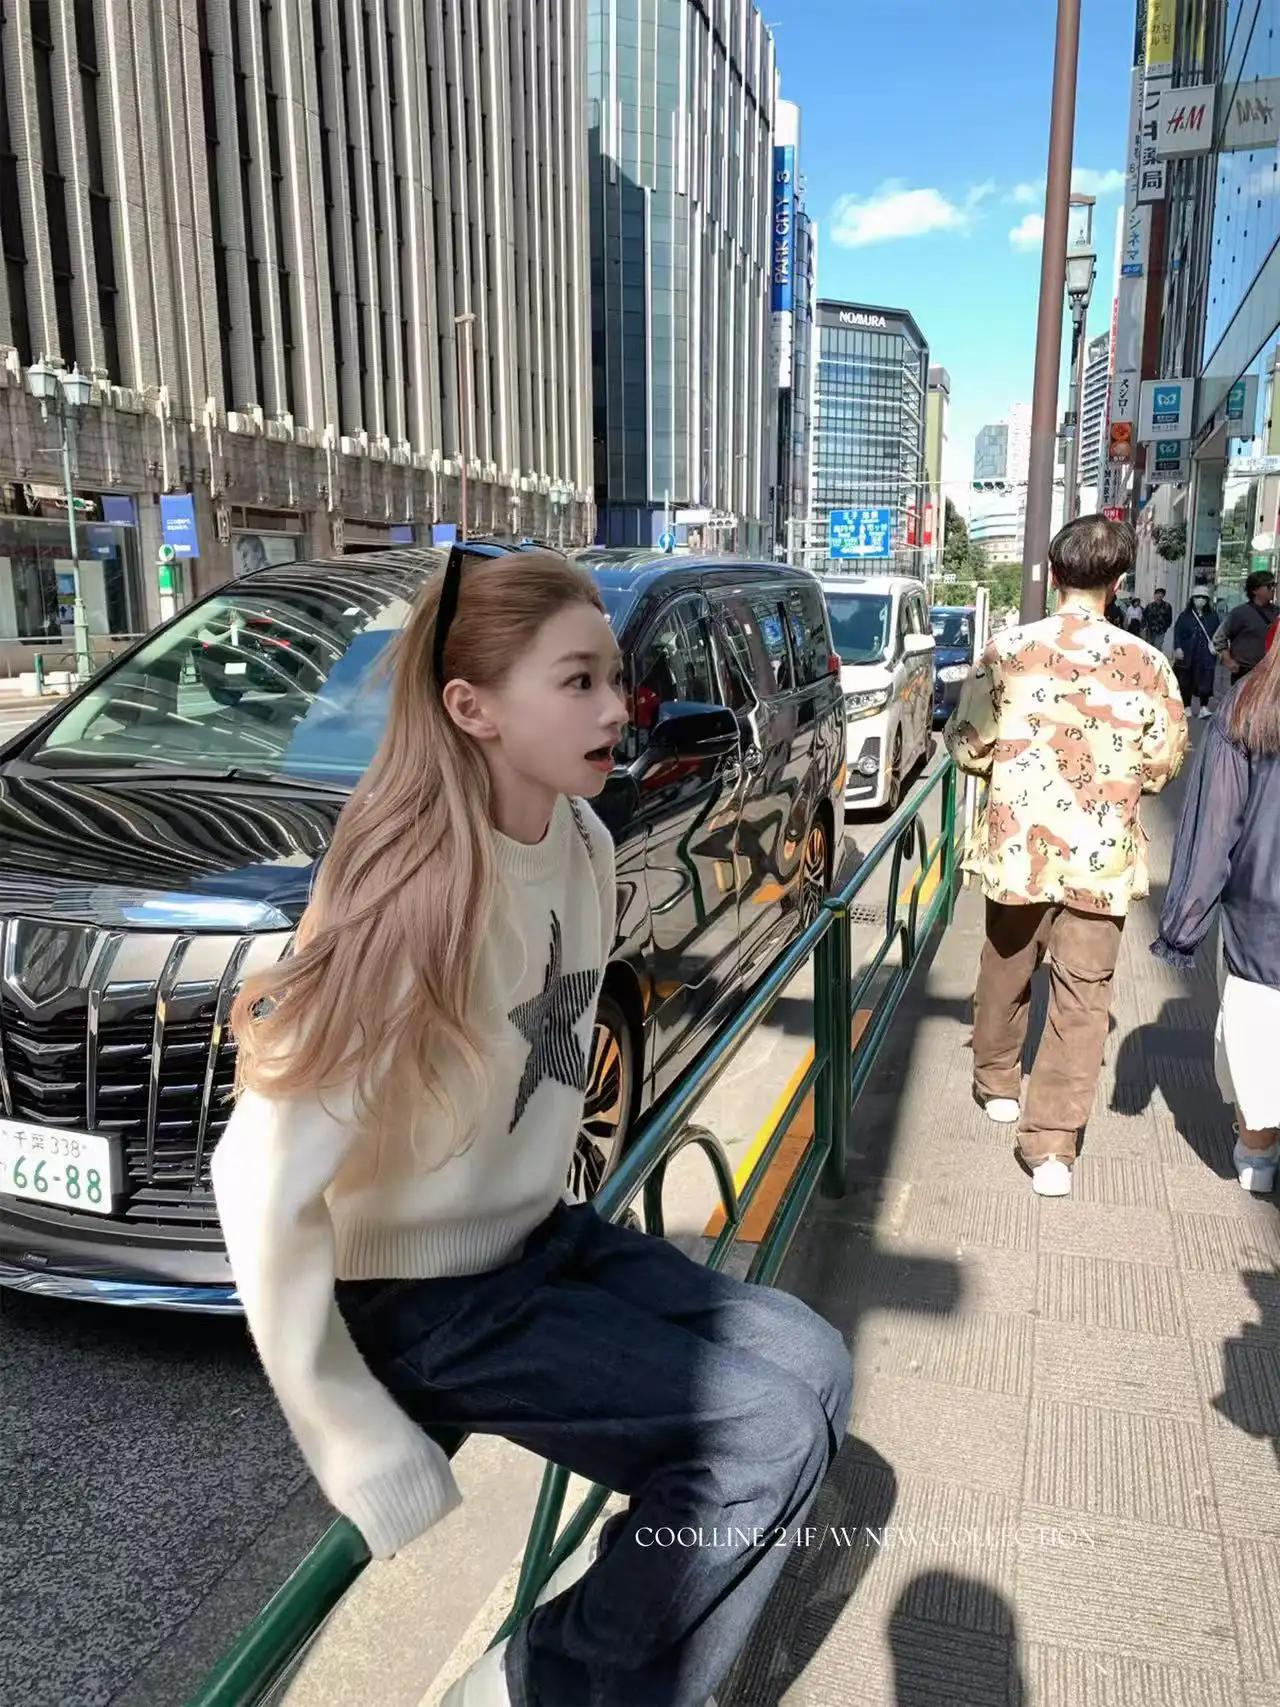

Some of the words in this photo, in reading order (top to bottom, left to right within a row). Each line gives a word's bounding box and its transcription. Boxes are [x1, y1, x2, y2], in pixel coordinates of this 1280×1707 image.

[1166, 104, 1206, 134] H&M
[775, 196, 790, 236] CITY
[774, 240, 789, 284] PARK
[839, 311, 886, 328] NOMURA
[1118, 379, 1129, 416] スシロー
[13, 1155, 103, 1204] 66-88
